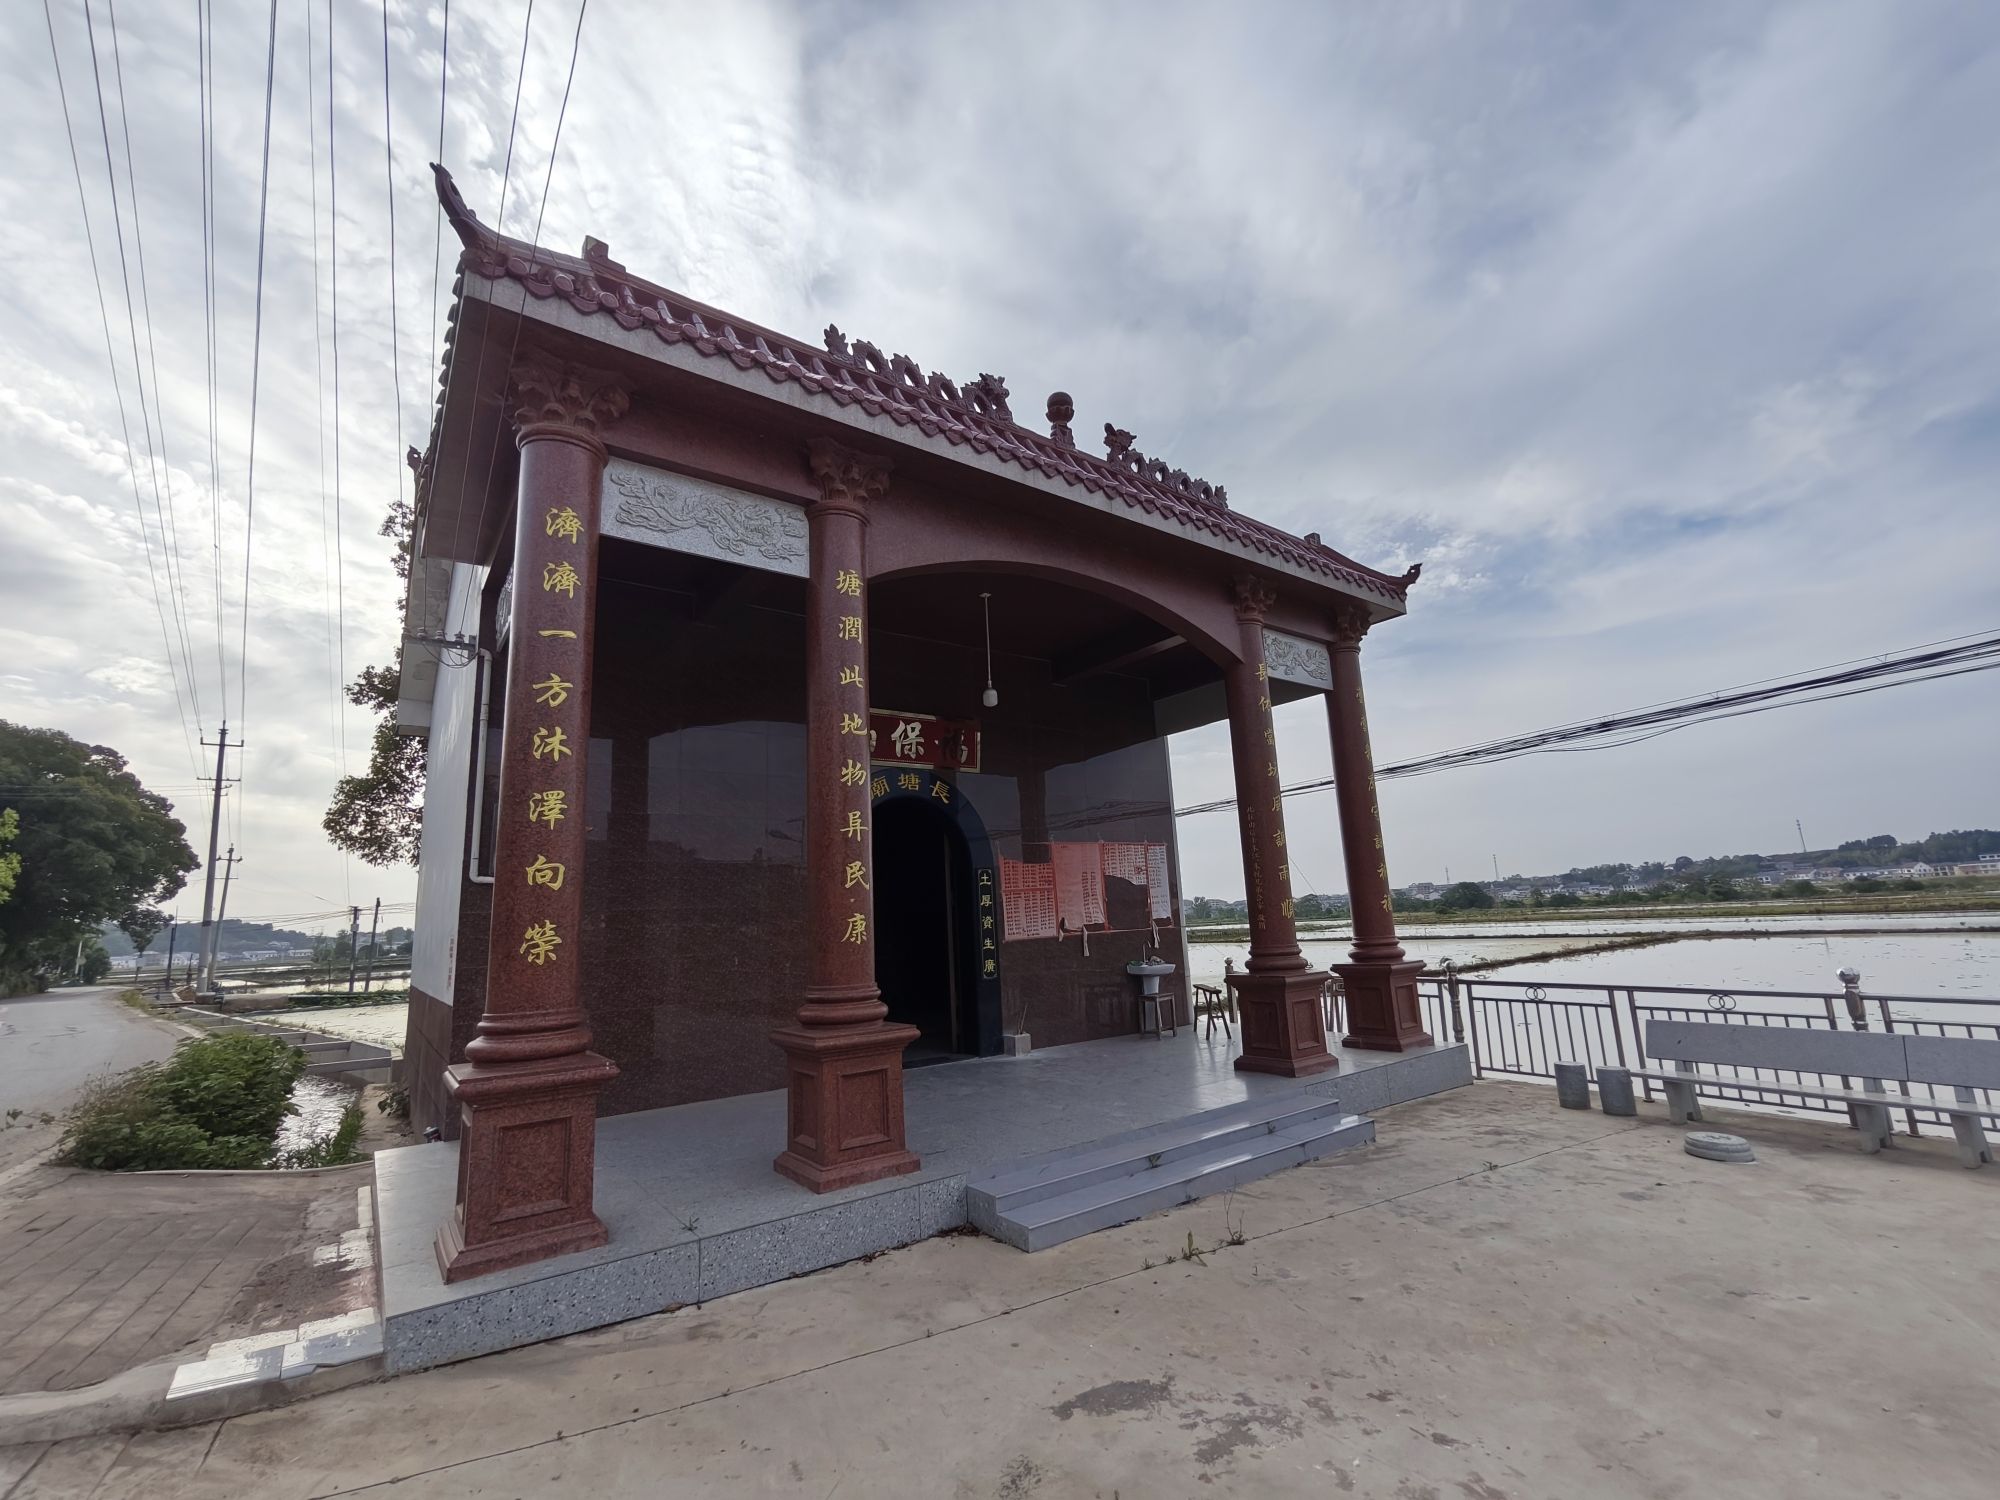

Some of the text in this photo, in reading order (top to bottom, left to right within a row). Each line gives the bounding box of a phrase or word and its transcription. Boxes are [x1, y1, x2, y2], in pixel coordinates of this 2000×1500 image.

[520, 506, 584, 966] 濟濟一方沐澤向榮
